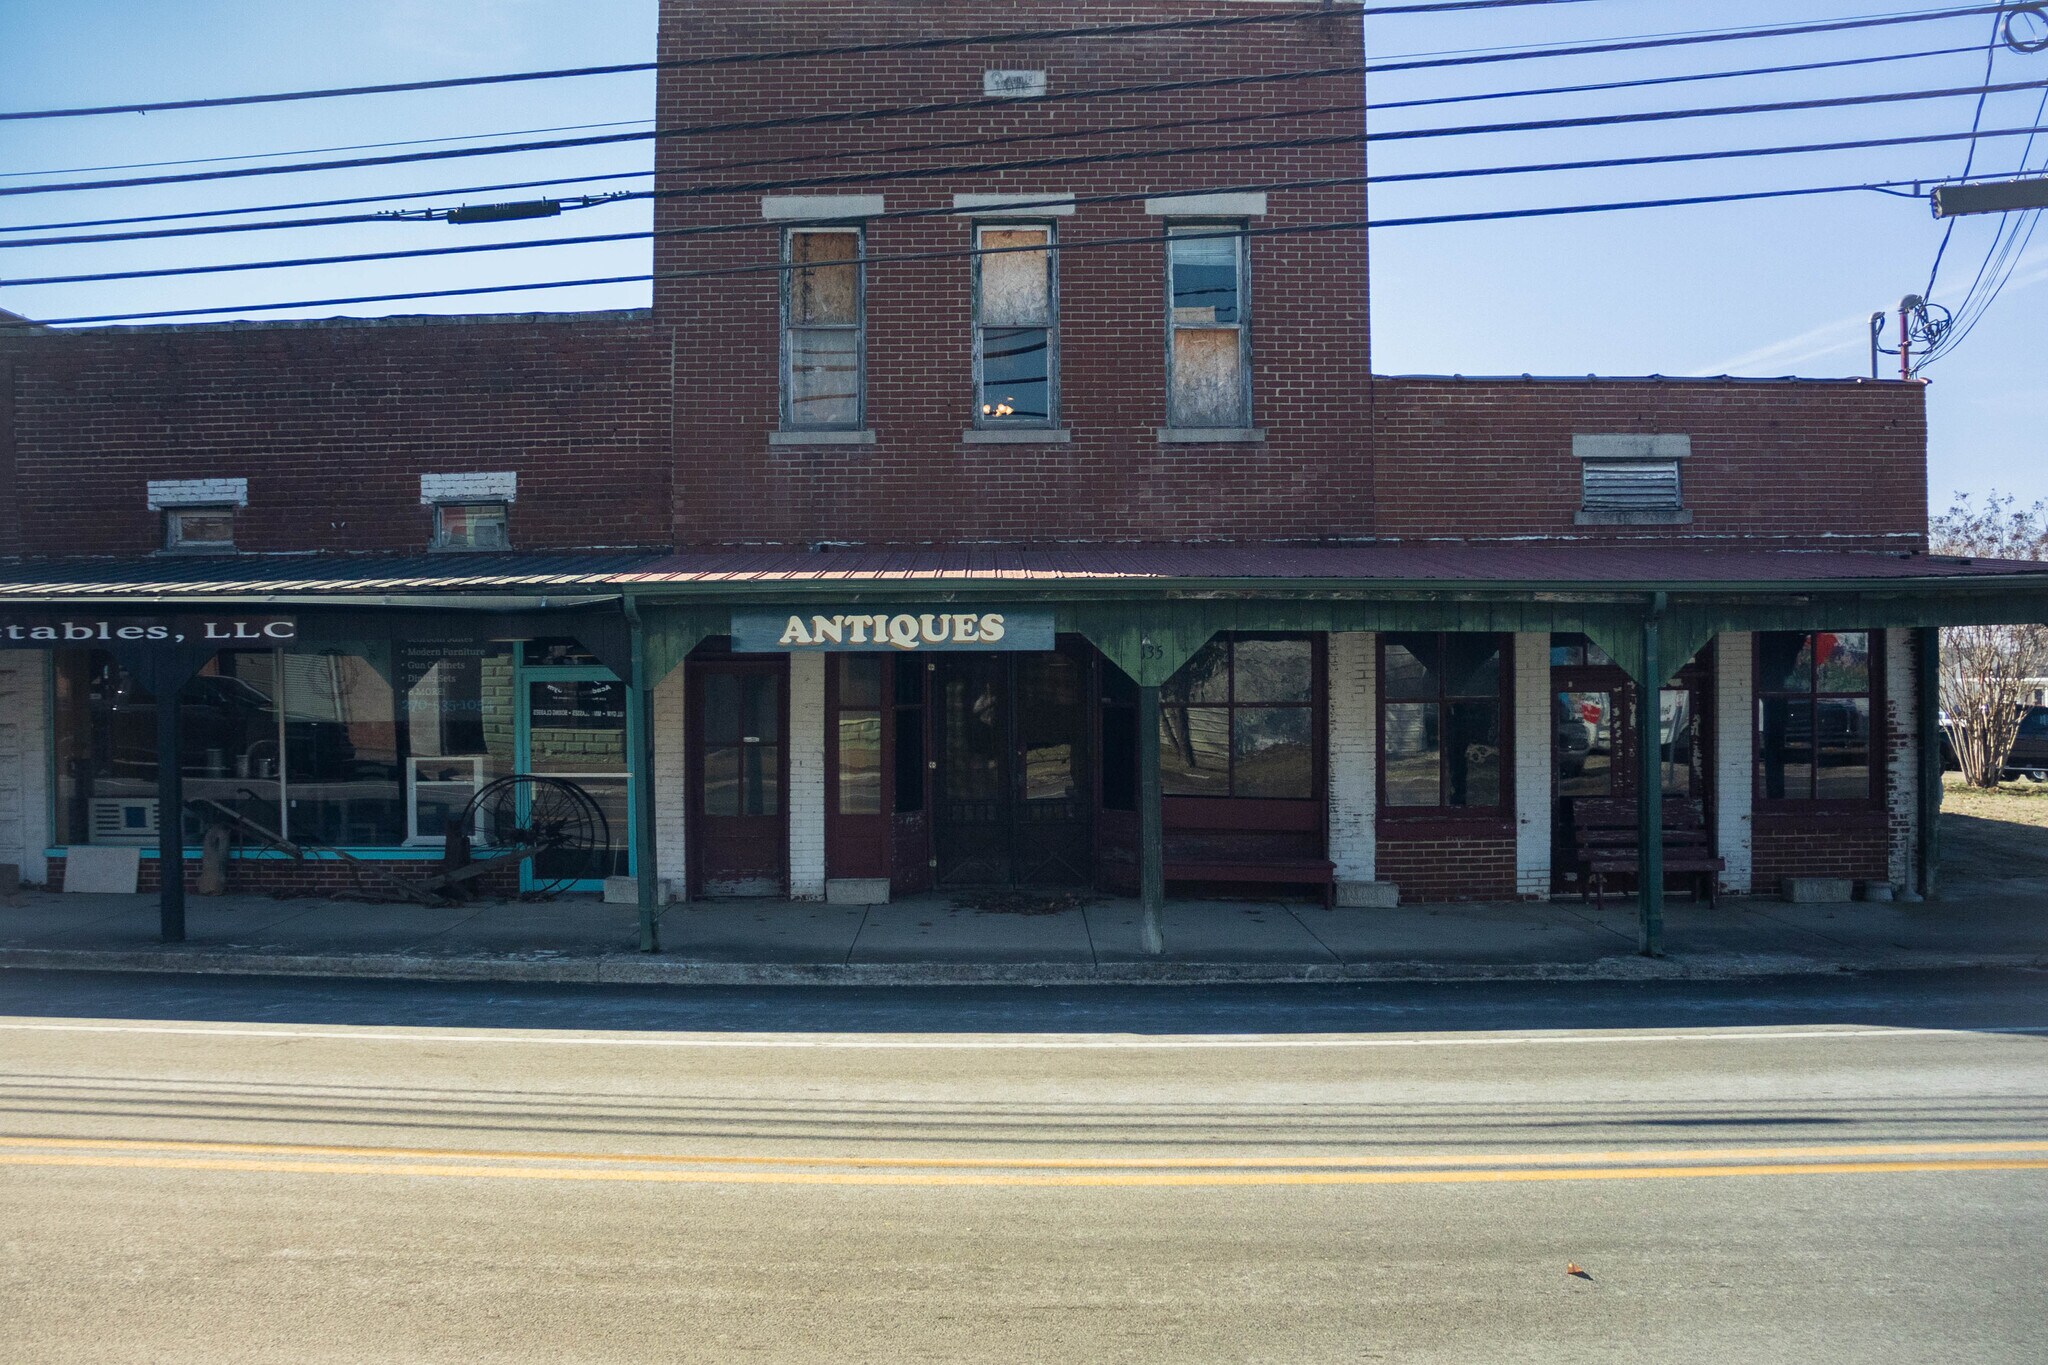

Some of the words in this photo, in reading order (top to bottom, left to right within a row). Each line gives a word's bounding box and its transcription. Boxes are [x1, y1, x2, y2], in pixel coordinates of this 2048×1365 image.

[0, 621, 185, 643] tables,
[203, 622, 295, 639] LLC
[779, 613, 1006, 650] ANTIQUES
[407, 647, 441, 656] Modern
[442, 647, 486, 656] Furniture
[407, 661, 426, 669] Gun
[427, 661, 465, 669] Cbinets
